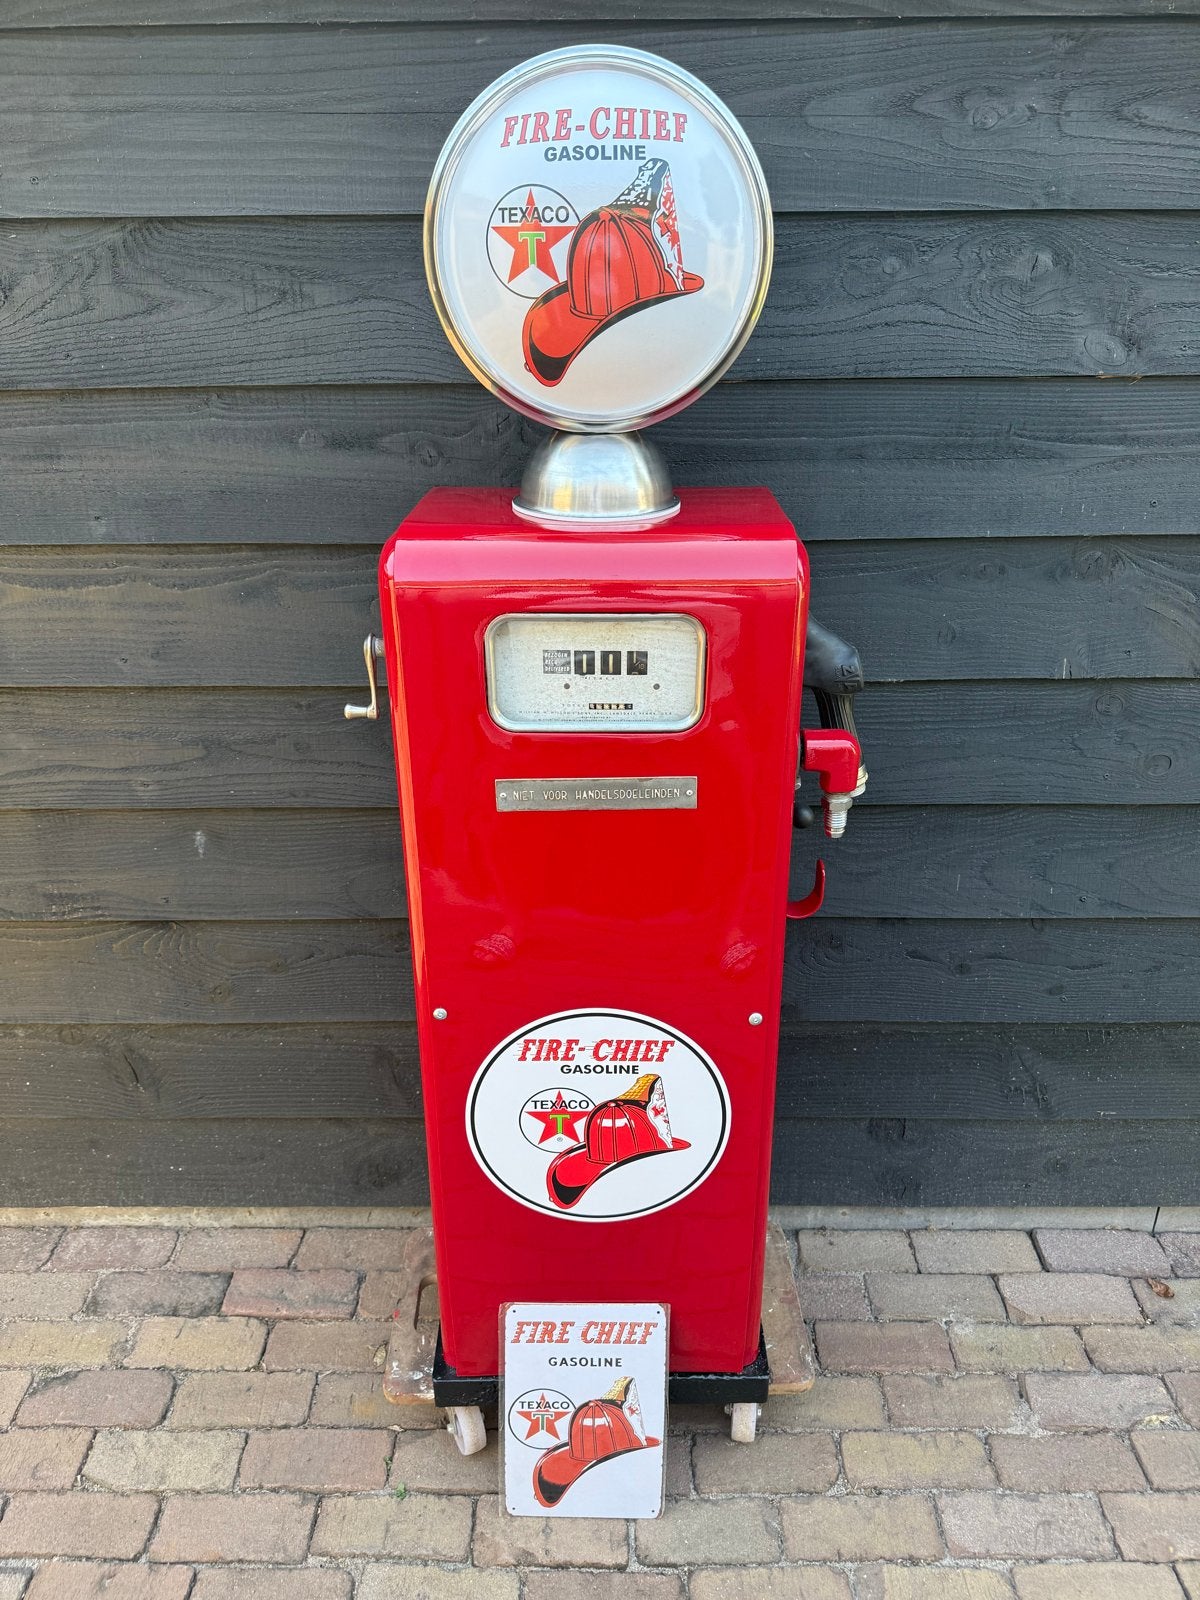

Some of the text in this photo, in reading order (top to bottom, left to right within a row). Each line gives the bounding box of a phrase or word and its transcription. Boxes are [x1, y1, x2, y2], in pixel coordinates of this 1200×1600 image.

[500, 107, 688, 148] FIRE-CHIEF
[543, 145, 646, 162] GASOLINE
[498, 205, 570, 224] TEXACO
[513, 788, 681, 801] NIET VOOR HANDELSDOELEINDEN
[560, 1064, 640, 1075] GASOLINE
[531, 1099, 590, 1110] TEXACO
[510, 1320, 659, 1345] FIRE CHIEF
[548, 1356, 623, 1368] GASOLINE
[519, 1400, 570, 1410] TEXACO
